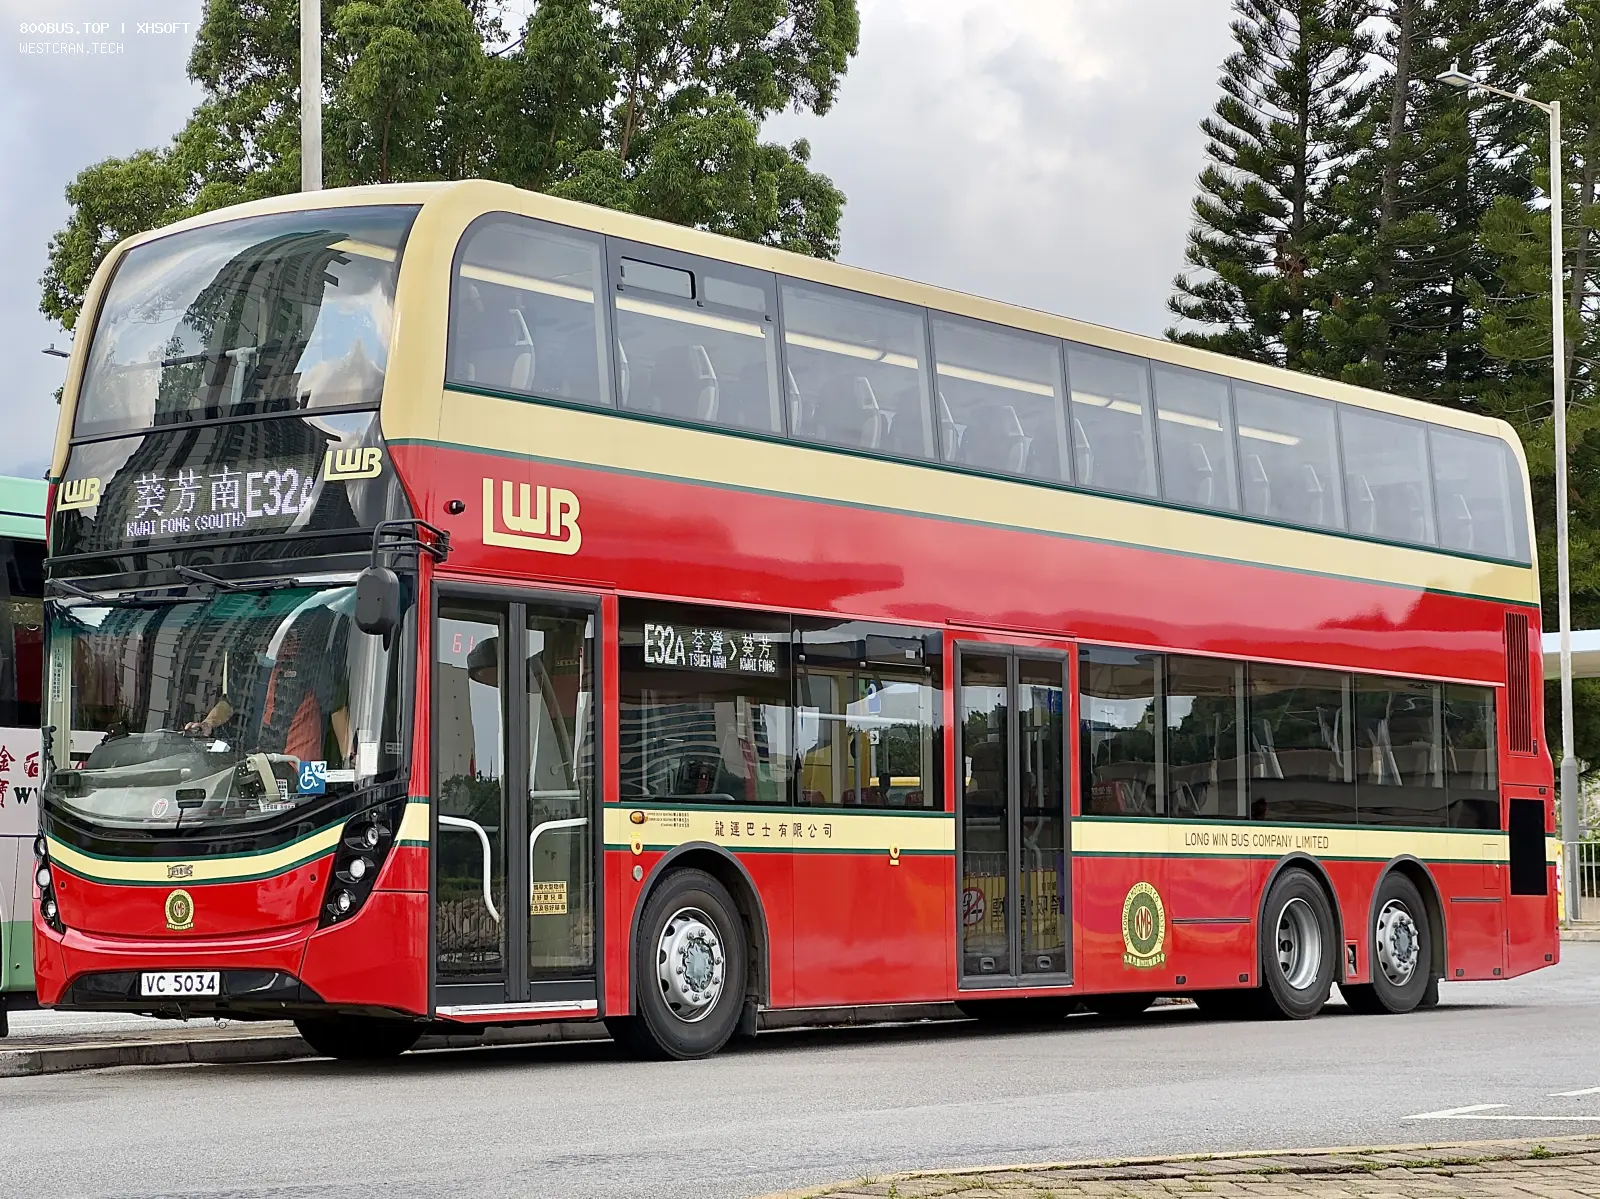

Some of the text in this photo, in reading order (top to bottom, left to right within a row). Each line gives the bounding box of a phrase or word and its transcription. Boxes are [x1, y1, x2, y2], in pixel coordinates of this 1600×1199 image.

[323, 447, 383, 481] LWB
[56, 477, 101, 511] LWB
[133, 465, 242, 518] 葵芳南
[126, 511, 246, 537] KWAI FONG (SOUTH)
[482, 477, 582, 556] LWB
[644, 623, 685, 665] E32A
[692, 628, 772, 659] 荃灣 葵芳
[740, 657, 757, 672] KWAI
[758, 658, 776, 673] FONG
[714, 820, 832, 838] 龍運巴士有限公司
[1185, 832, 1329, 849] LONG WIN BUS COMPANY LIMITED
[1135, 906, 1153, 940] KMB
[146, 974, 216, 993] VC 5034
